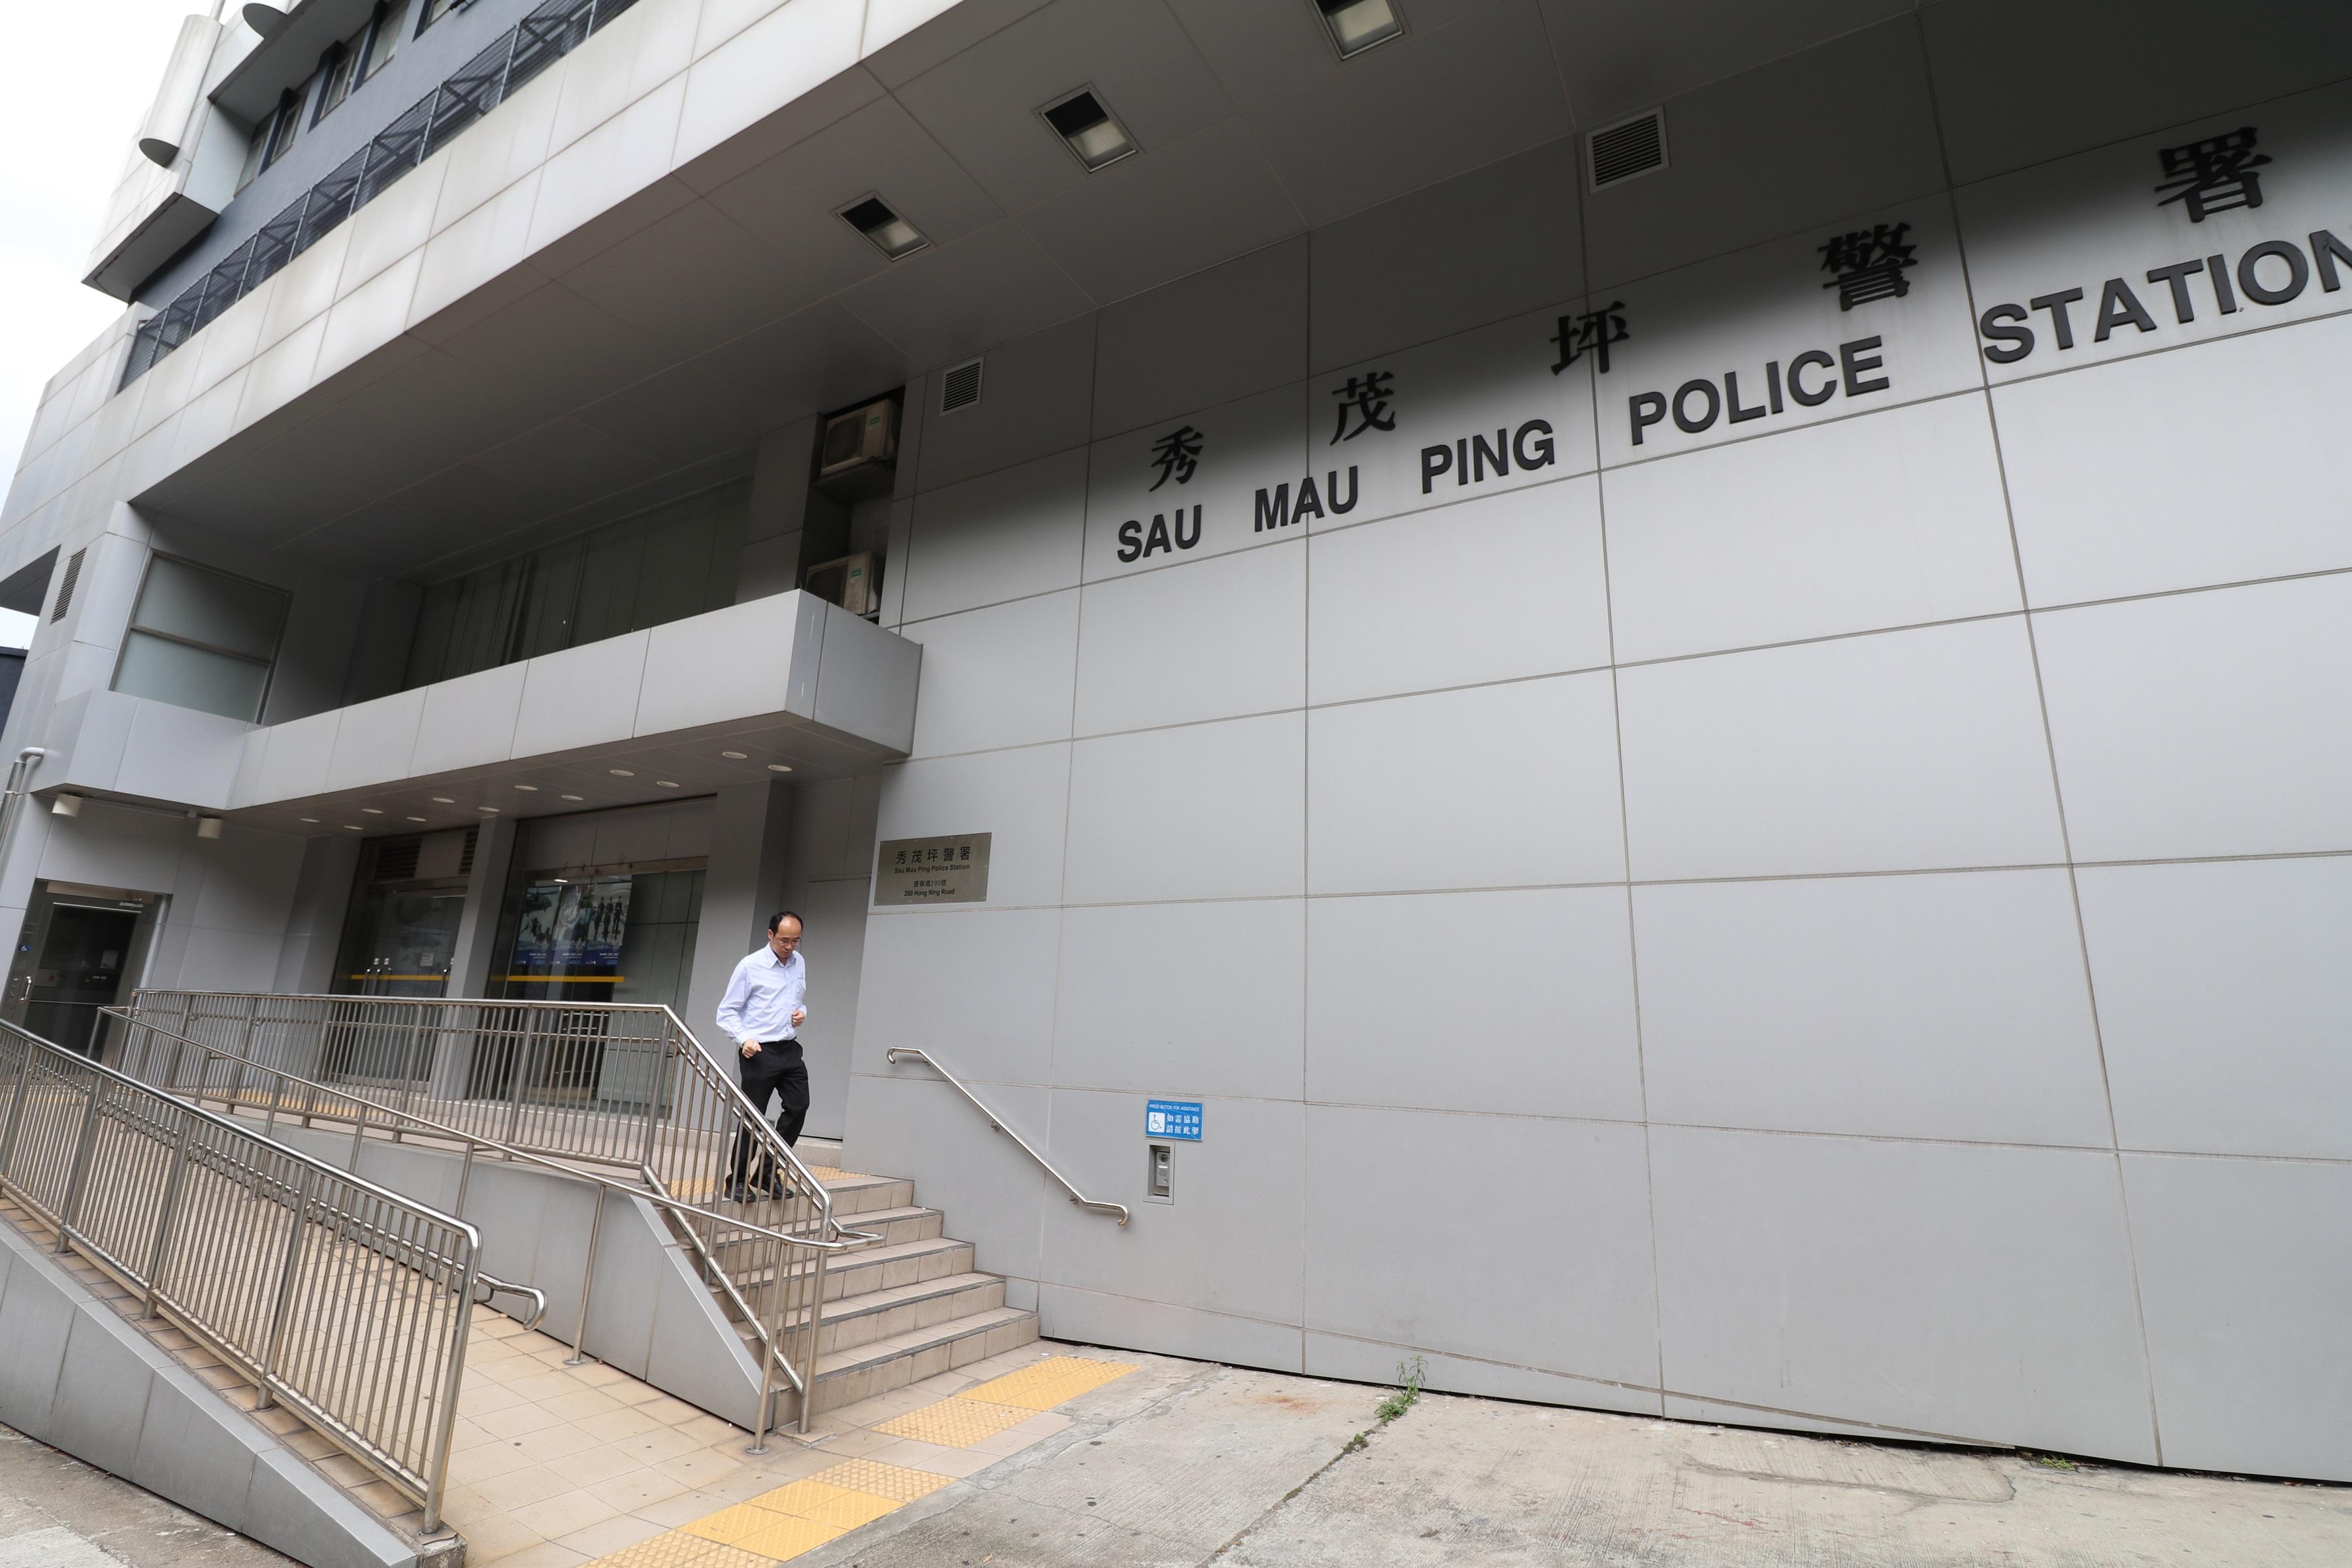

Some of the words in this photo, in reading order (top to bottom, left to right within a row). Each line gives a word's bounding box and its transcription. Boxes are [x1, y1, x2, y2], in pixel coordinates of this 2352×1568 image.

[1117, 504, 1202, 563] SAU
[1254, 465, 1358, 532] MAU
[1421, 419, 1555, 495] PING
[1629, 335, 1890, 446] POLICE
[1980, 229, 2352, 364] STATION
[896, 846, 971, 865] 秀茂坪警署
